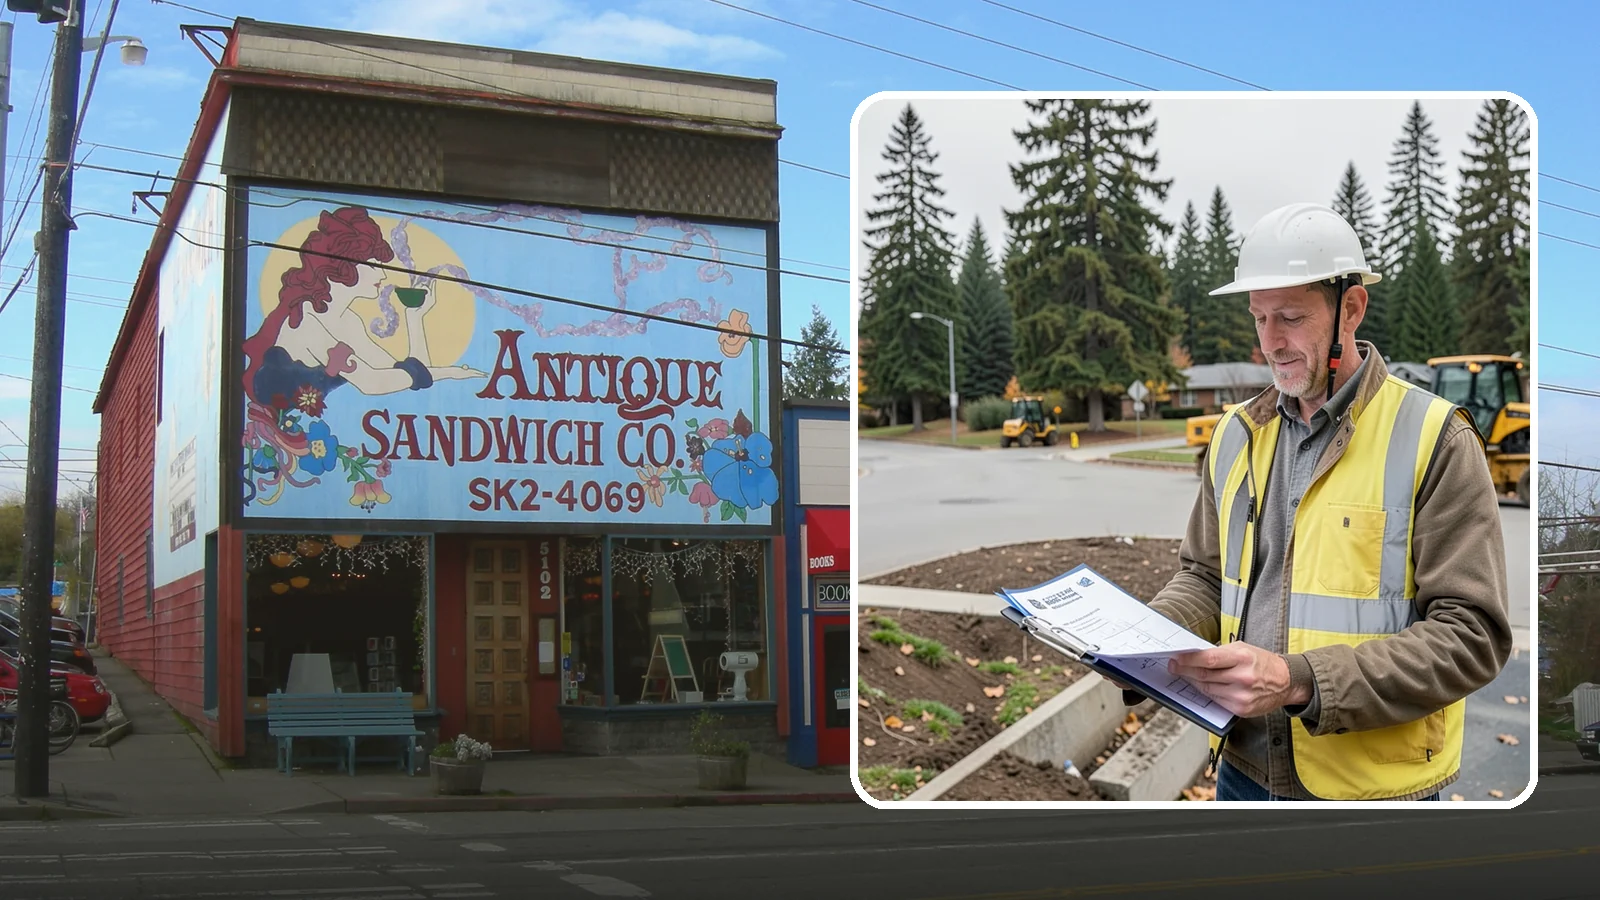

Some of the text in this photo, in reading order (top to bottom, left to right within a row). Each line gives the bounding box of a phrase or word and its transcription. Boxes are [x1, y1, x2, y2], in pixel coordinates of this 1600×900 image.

[476, 329, 723, 420] ANTIQUE
[361, 408, 685, 469] SANDWICH CO.
[468, 477, 646, 513] SK2-4069
[539, 541, 552, 600] 5102
[809, 555, 835, 569] BOOKS
